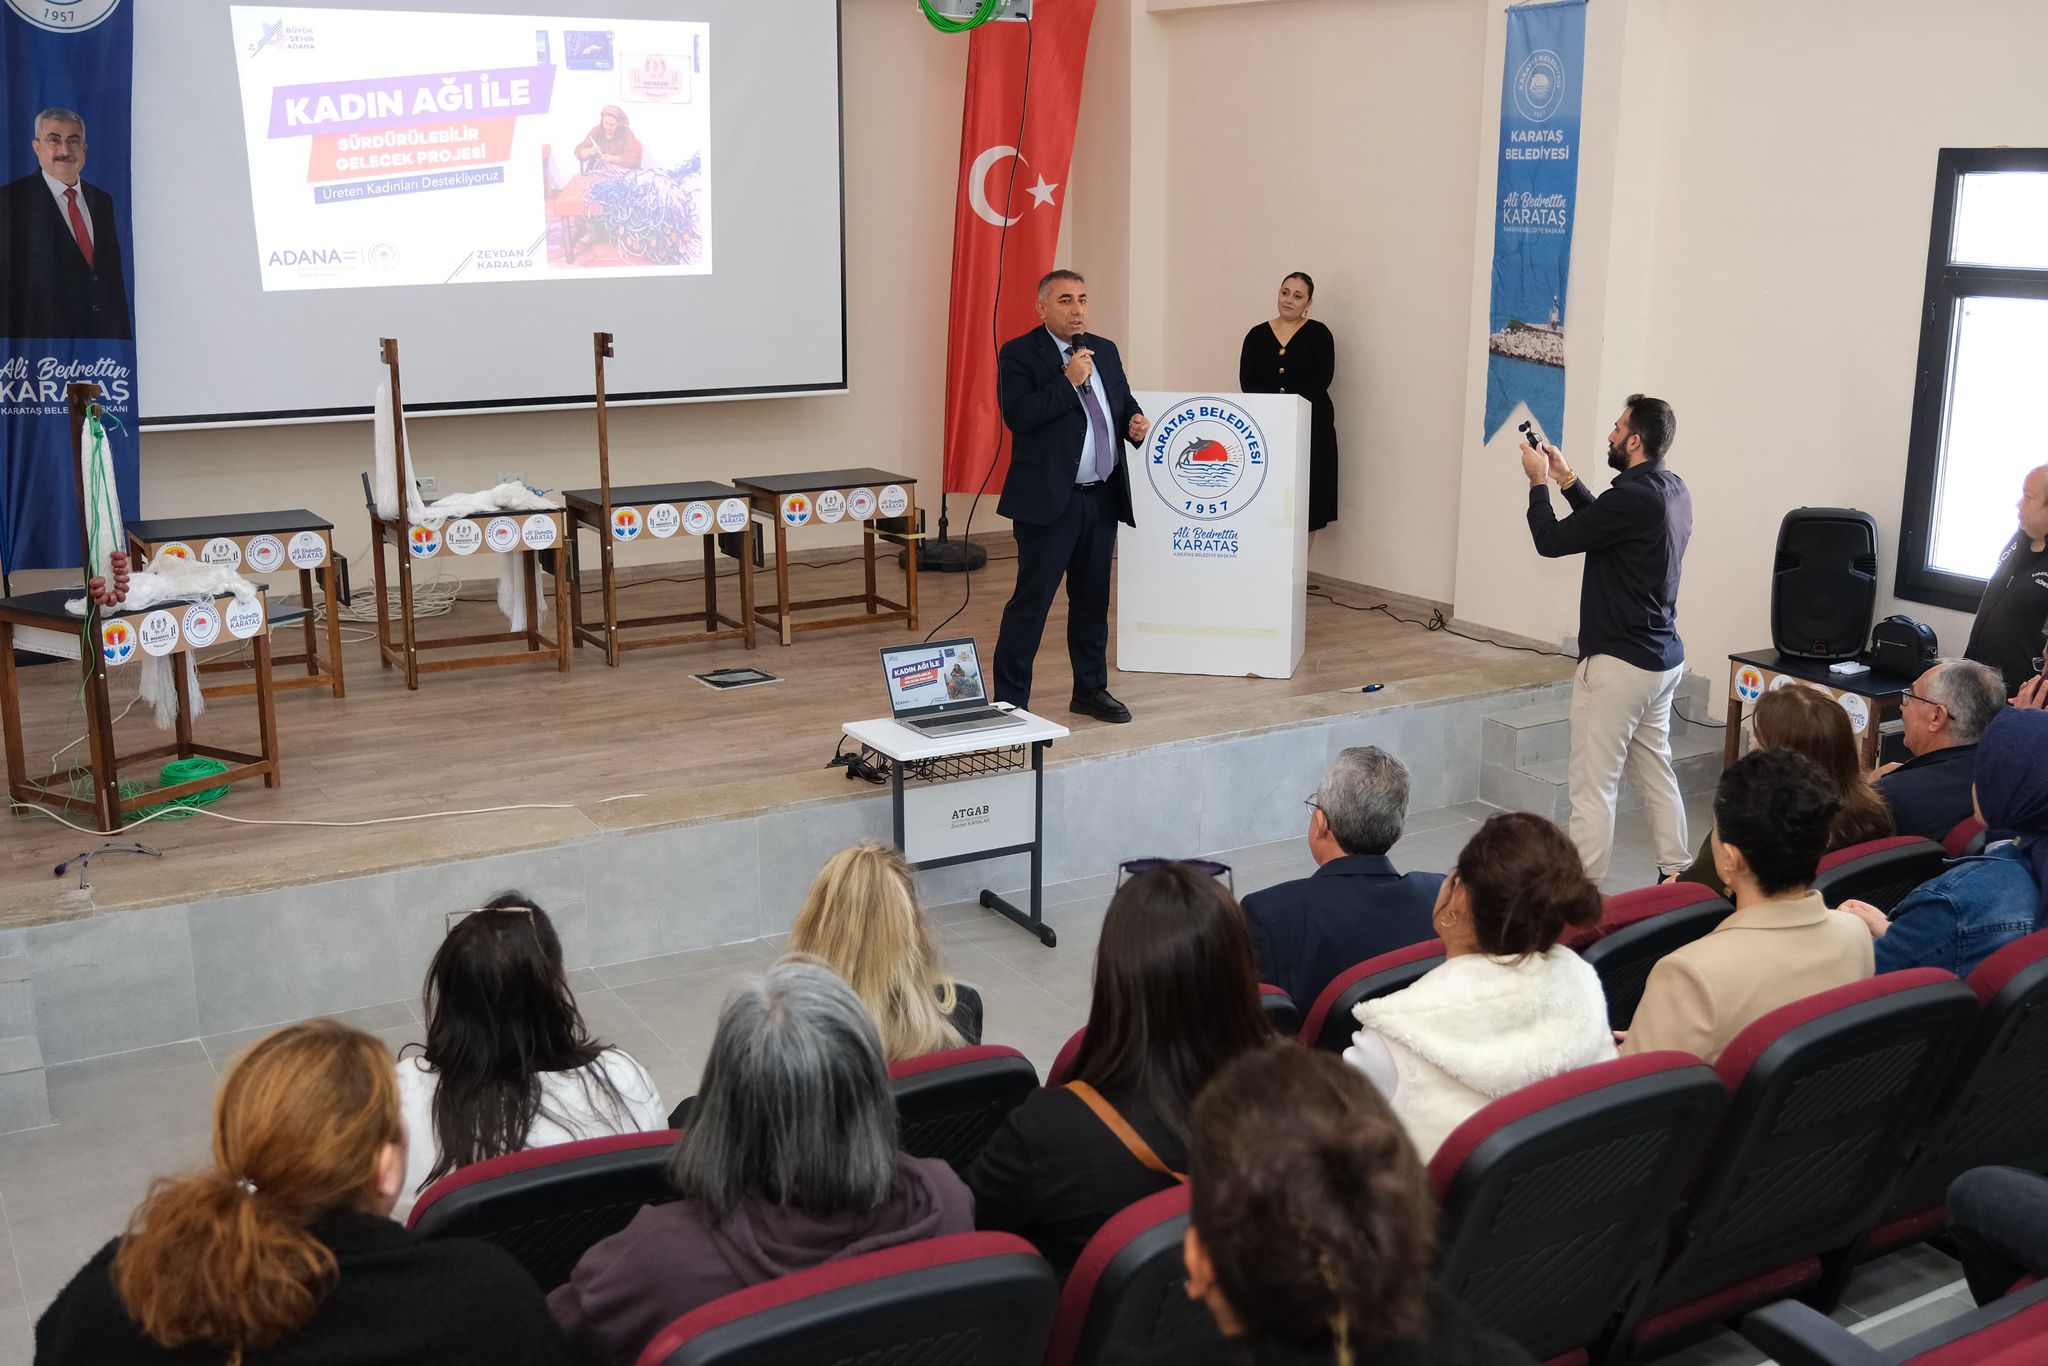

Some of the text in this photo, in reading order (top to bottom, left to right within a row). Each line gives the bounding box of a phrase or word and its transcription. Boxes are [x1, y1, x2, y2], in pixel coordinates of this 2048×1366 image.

[43, 8, 75, 22] 1957
[284, 73, 531, 126] KADIN AĞI İLE
[337, 124, 480, 152] SÜRDÜRÜLEBİLİR
[1510, 129, 1564, 144] KARATAŞ
[335, 143, 487, 171] GELECEK PROJESİ
[1505, 145, 1569, 160] BELEDİYESİ
[322, 169, 500, 201] Üreten Kadınları Destekliyoruz
[1503, 191, 1567, 209] Ali Bedrettin
[1503, 208, 1566, 229] KARATAŞ
[268, 249, 343, 267] ADANA
[476, 249, 524, 259] ZEYDAN
[477, 259, 533, 270] KARALAR
[0, 356, 131, 381] Ali Bedrettin
[1, 406, 42, 416] KARATAŞ
[1153, 406, 1264, 465] KARATAŞ BELEDİYESİ
[1184, 500, 1228, 514] 1957
[1172, 526, 1239, 540] Ali Bedrettin
[1172, 539, 1239, 554] KARATAŞ
[893, 667, 917, 677] KADIN
[917, 662, 930, 672] AĞI
[930, 659, 941, 668] İLE
[951, 805, 990, 820] ATGAB
